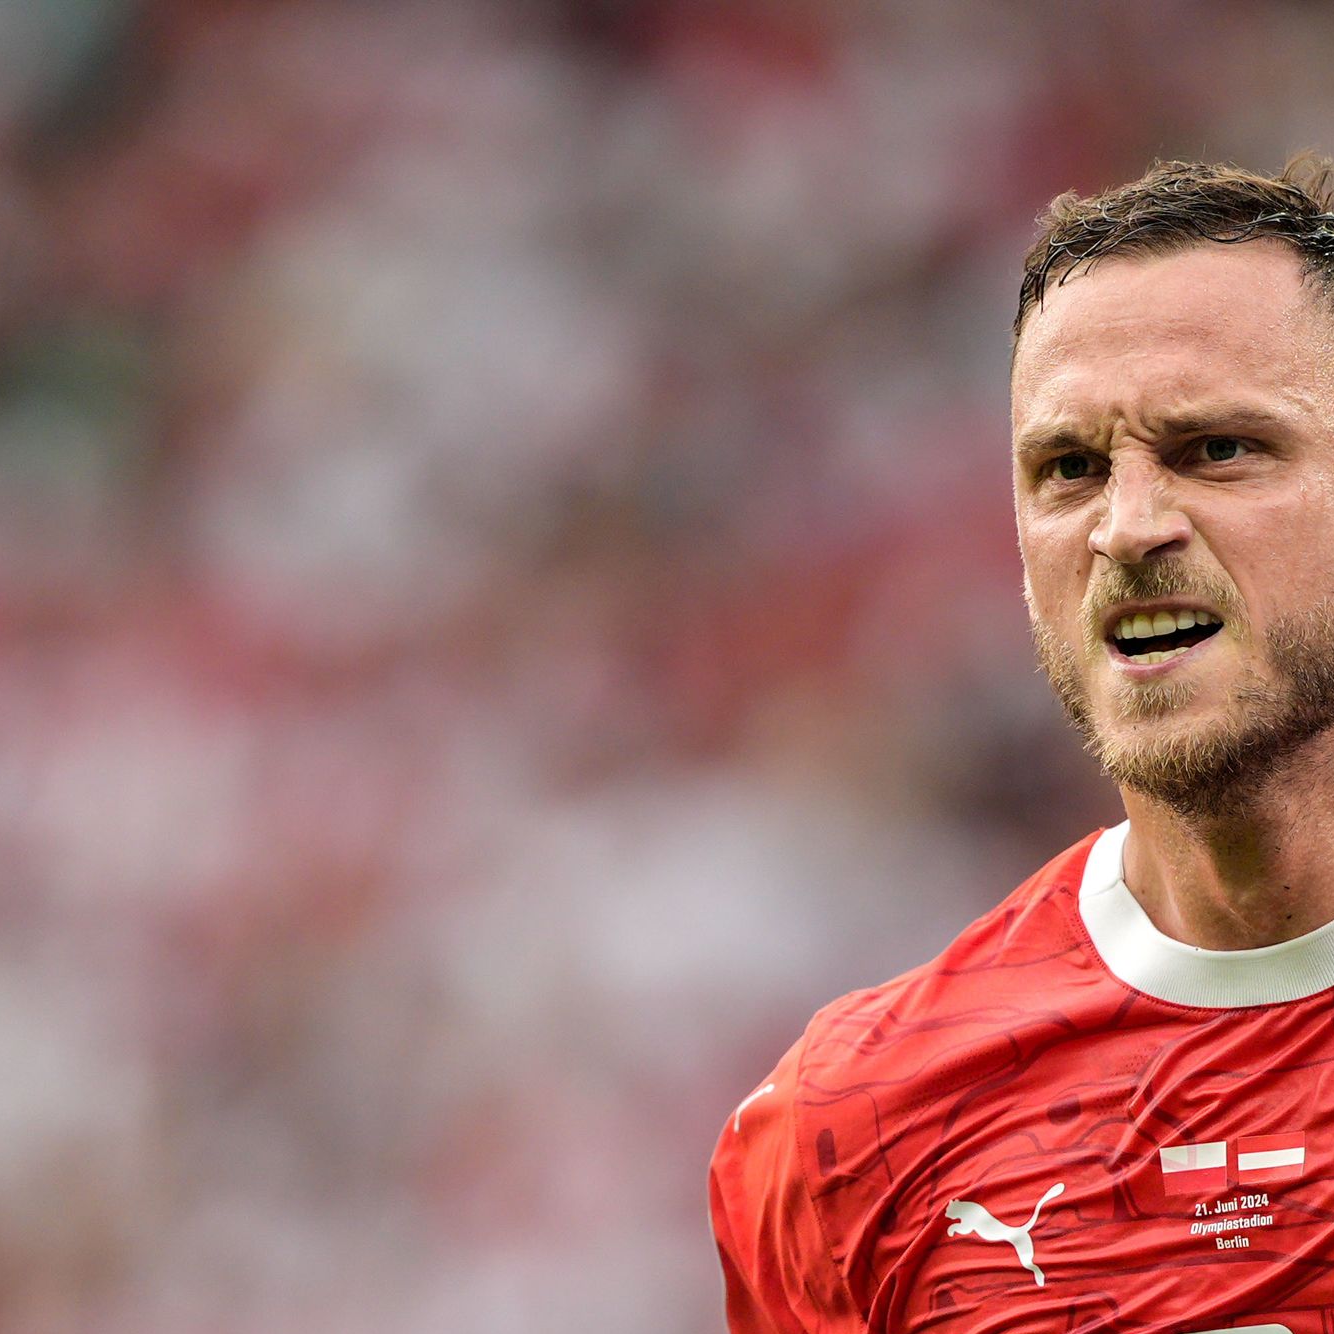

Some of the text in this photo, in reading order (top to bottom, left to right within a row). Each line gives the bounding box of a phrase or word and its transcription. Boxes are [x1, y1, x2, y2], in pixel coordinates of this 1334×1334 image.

[1194, 1193, 1269, 1217] 21. Juni 2024
[1190, 1214, 1274, 1236] Olympiastadion
[1215, 1235, 1250, 1250] Berlin
